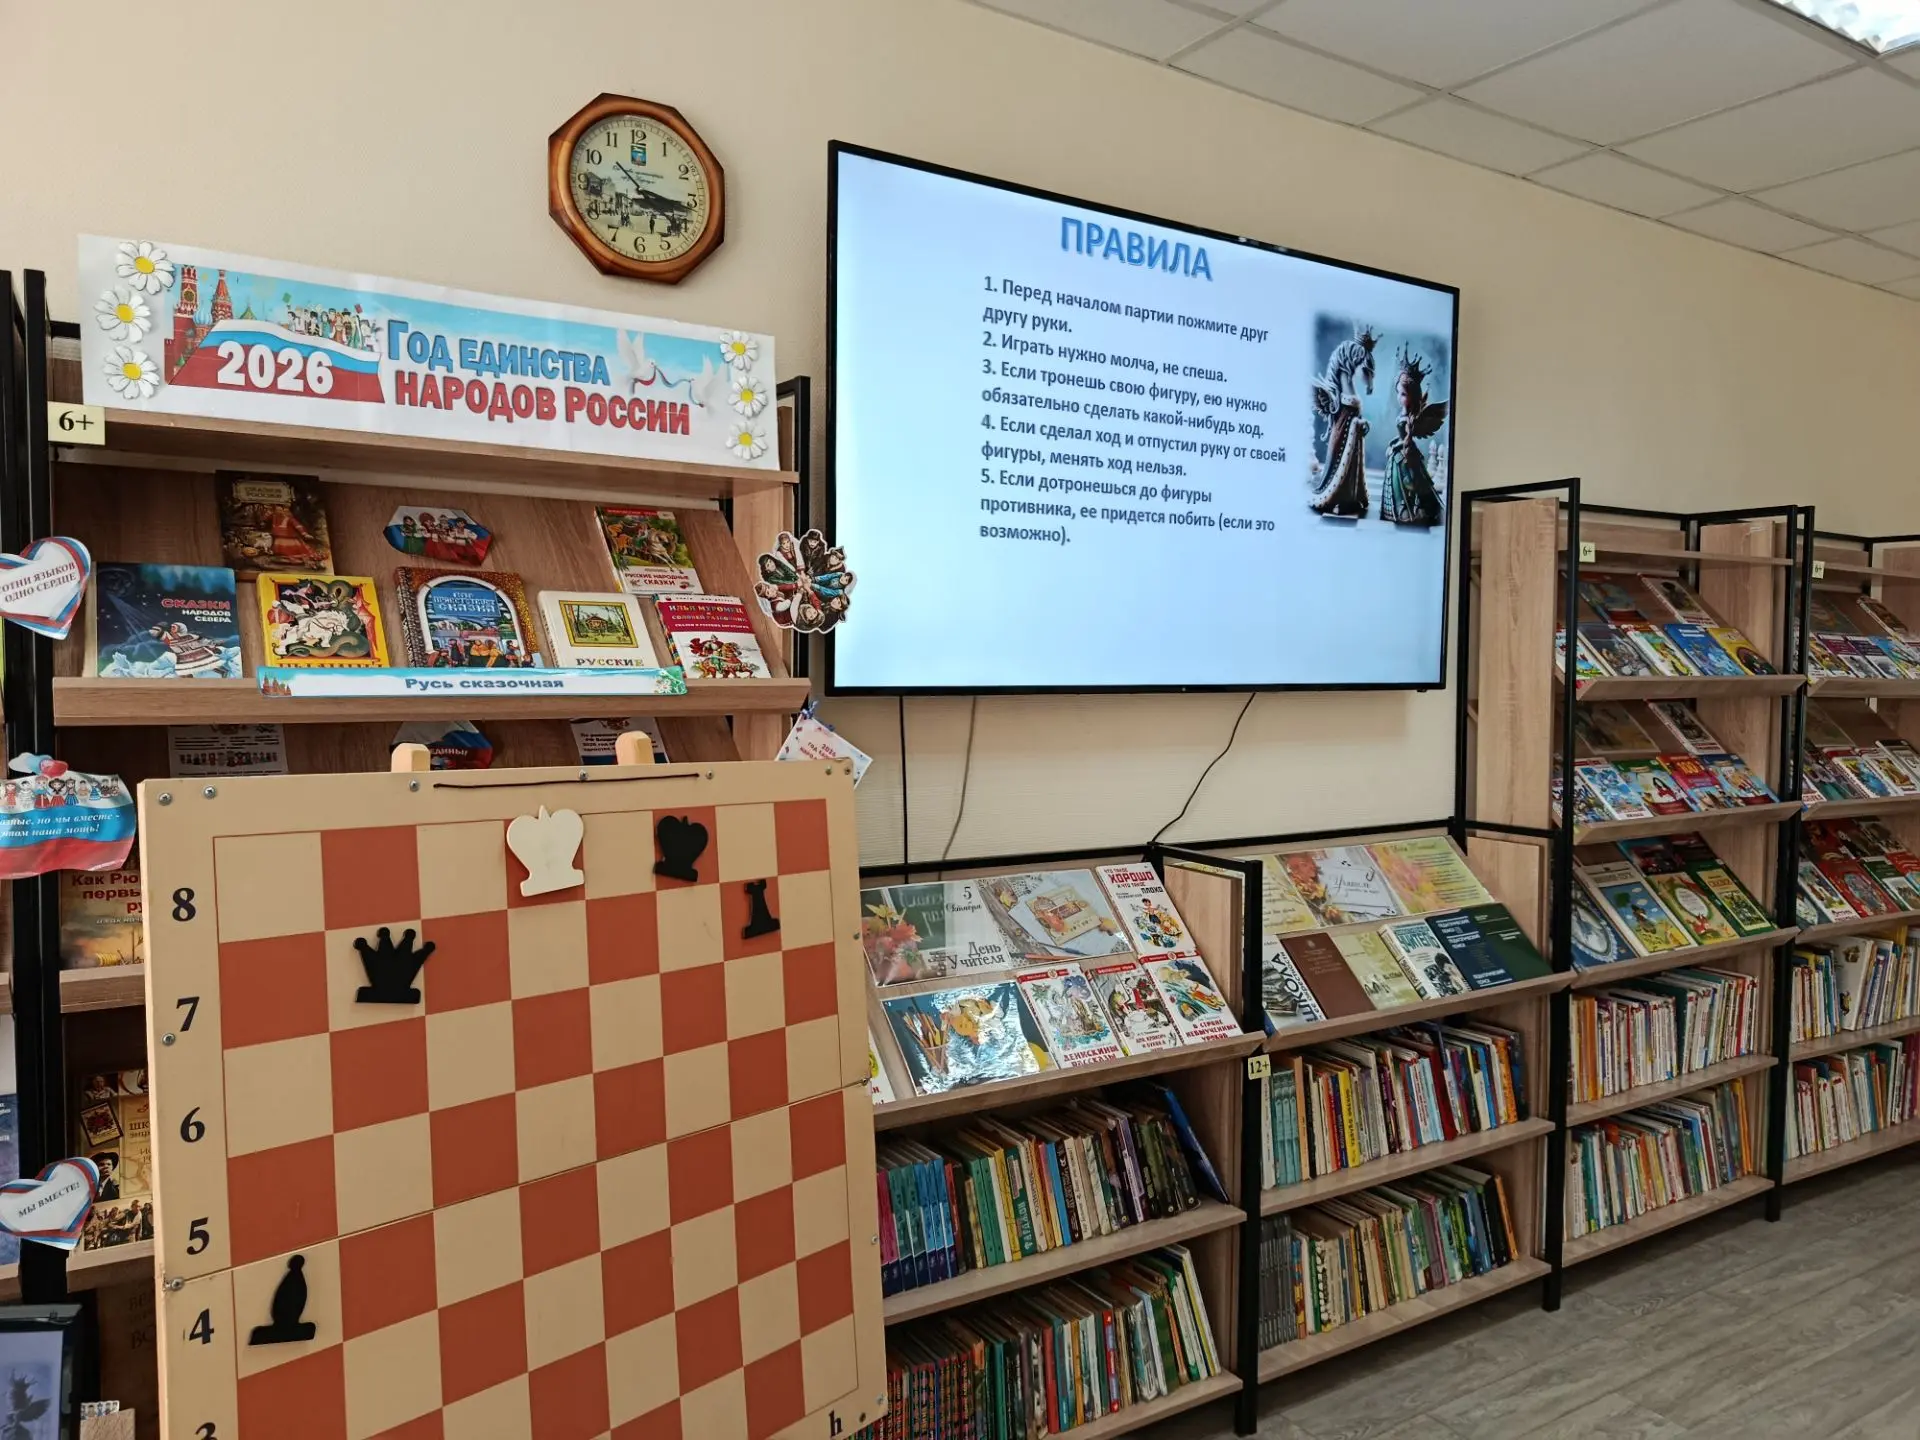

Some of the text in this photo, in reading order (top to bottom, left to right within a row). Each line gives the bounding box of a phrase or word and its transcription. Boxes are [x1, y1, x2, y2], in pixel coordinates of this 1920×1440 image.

[606, 131, 617, 148] 11
[630, 129, 646, 146] 12
[586, 149, 602, 165] 10
[661, 142, 667, 157] 1
[578, 172, 588, 190] 9
[678, 164, 689, 181] 2
[687, 193, 697, 209] 3
[607, 225, 619, 242] 7
[634, 236, 645, 253] 6
[659, 238, 671, 251] 5
[1061, 216, 1213, 281] ПРАВИЛА
[984, 275, 1269, 342] 1. Перед началом партии пожмите друг
[982, 305, 1073, 334] другу руки.
[459, 337, 611, 386] ЕДИНСТВА
[982, 331, 1228, 383] 2. Играть нужно молча, не спеша.
[216, 340, 334, 395] 2026
[982, 358, 1267, 413] 3. Если тронешь свою фигуру, ею нужно
[394, 369, 691, 436] НАРОДОВ РОССИИ
[58, 410, 95, 432] 6+
[982, 388, 1265, 437] обязательно сделать какой-нибудь ход.
[981, 414, 1287, 463] 4. Если сделал ход и отпустил руку от своей
[981, 440, 1187, 477] фигуры, менять ход нельзя.
[981, 468, 1212, 504] 5. Если дотронешься до фигуры
[980, 498, 1275, 532] противника, ее придется побить (если это
[979, 523, 1071, 546] возможно).
[1582, 545, 1593, 556] 6+
[0, 561, 76, 594] ОТНИ ЯЗЫКОВ
[5, 572, 77, 603] ОДНО СЕРДЦЕ
[161, 598, 232, 611] СКАЗКИ
[181, 609, 232, 617] НАРОДОВ
[194, 615, 232, 623] СЕВЕРА
[576, 657, 645, 668] РУССКИЕ
[405, 678, 564, 691] Русь сказочная
[36, 816, 51, 826] но
[55, 814, 70, 823] мы
[74, 812, 113, 822] вместе
[32, 827, 62, 837] наша
[64, 823, 100, 836] мощь!
[72, 874, 104, 886] Как
[1108, 871, 1155, 884] ХОРОШО
[963, 886, 972, 900] 5
[1141, 886, 1164, 894] ПЛОХО
[172, 887, 197, 922] 8
[968, 941, 1001, 958] День
[946, 954, 1006, 970] Учителя
[1271, 953, 1319, 1022] ШКОЛА
[176, 996, 200, 1033] 7
[1063, 1045, 1119, 1062] ДЕНИСКИНЫ
[1249, 1060, 1270, 1074] 12+
[180, 1106, 206, 1143] 6
[18, 1181, 81, 1218] МЫ ВМЕСТЕ!
[186, 1217, 210, 1255] 5
[188, 1308, 215, 1345] 4
[828, 1408, 843, 1438] h
